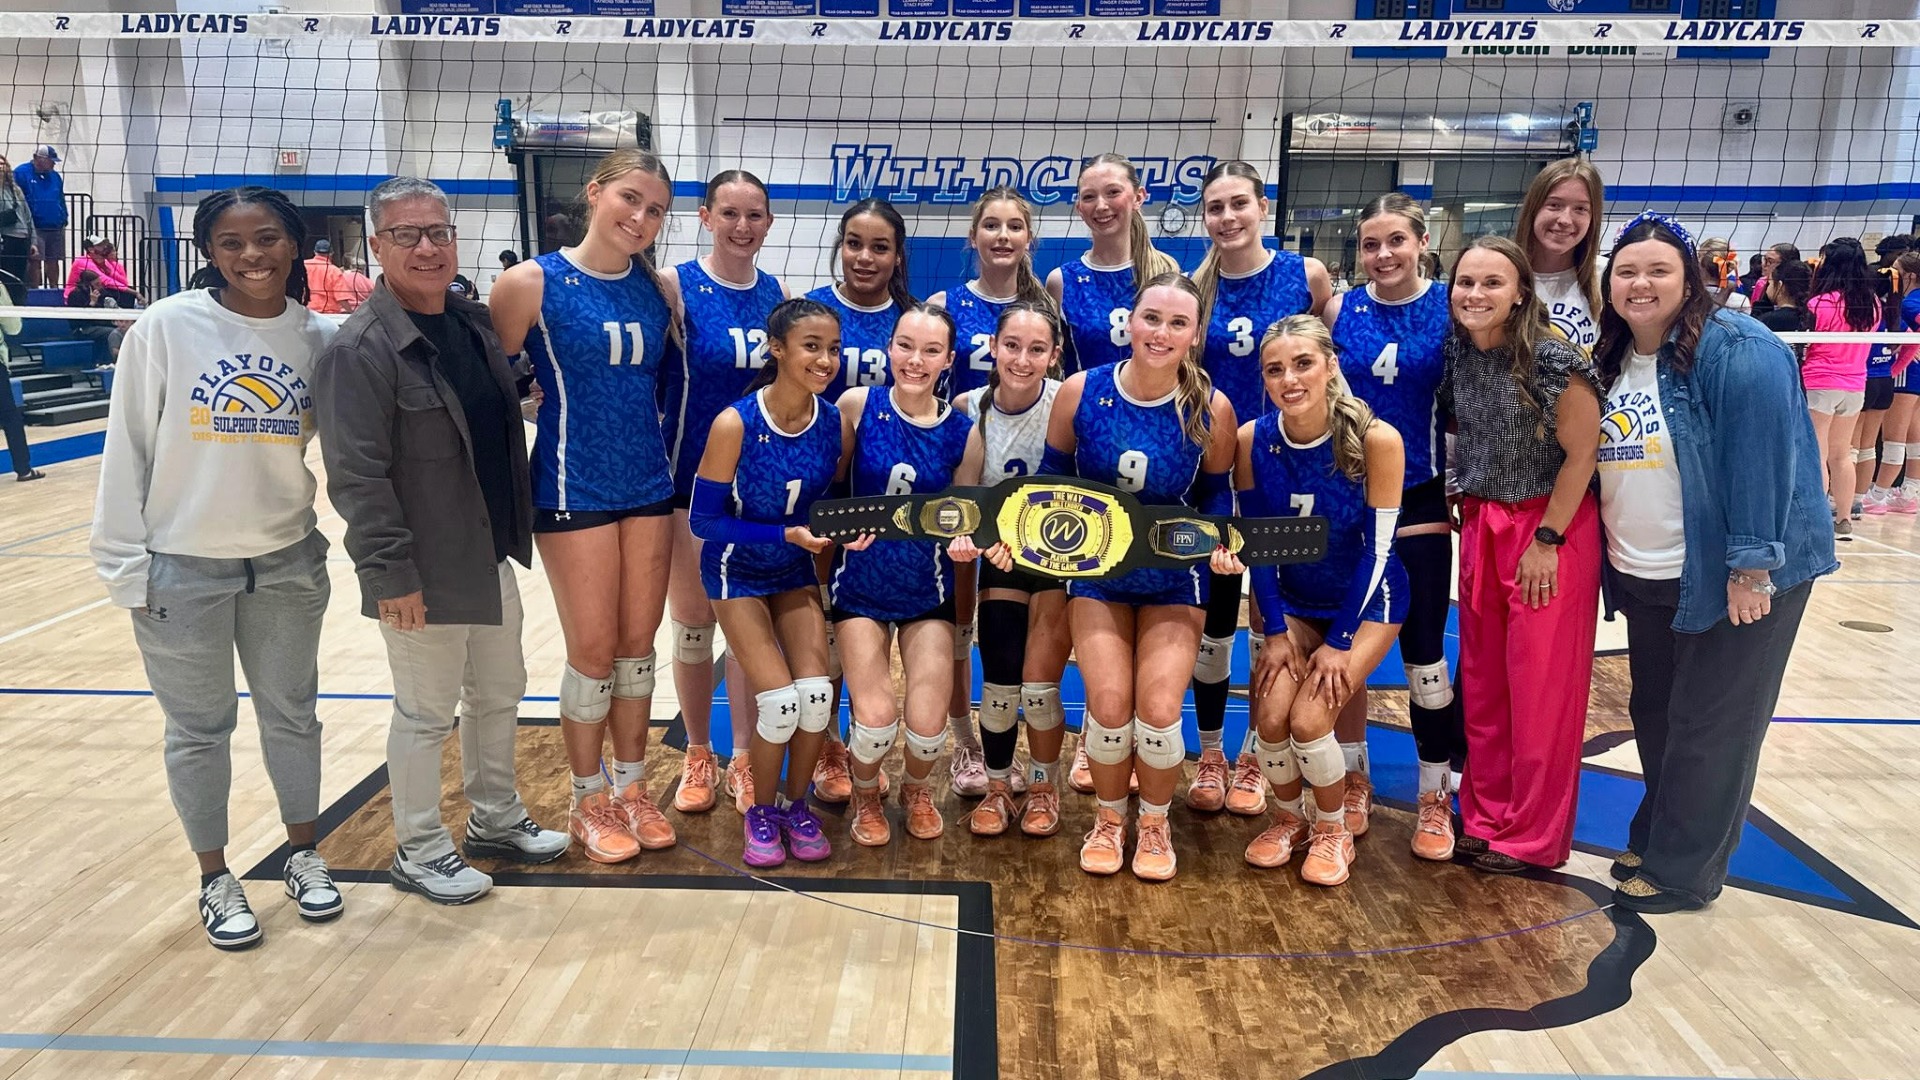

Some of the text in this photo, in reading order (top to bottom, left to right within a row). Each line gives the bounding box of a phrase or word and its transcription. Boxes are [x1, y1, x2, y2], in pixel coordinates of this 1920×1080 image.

[121, 14, 249, 33] LADYCATS
[370, 16, 501, 36] LADYCATS
[623, 19, 756, 38] LADYCATS
[878, 21, 1013, 41] LADYCATS
[1137, 21, 1274, 41] LADYCATS
[1398, 21, 1538, 40] LADYCATS
[1664, 21, 1806, 41] LADYCATS
[282, 152, 298, 164] EXIT
[830, 144, 1218, 207] WILDCTS
[602, 321, 645, 366] 11
[1109, 307, 1133, 347] 8
[1227, 316, 1255, 357] 3
[728, 327, 771, 369] 12
[1371, 342, 1400, 385] 4
[191, 353, 313, 410] PLAYOFFS
[843, 347, 888, 387] 13
[189, 406, 211, 426] 20
[214, 416, 300, 436] SULPHUR SPRINGS
[1604, 392, 1660, 435] AYOFFS
[192, 432, 248, 444] DISTRICT
[1617, 444, 1645, 460] SPRINGS
[885, 462, 917, 496] 6
[1116, 450, 1149, 494] 9
[784, 479, 802, 516] 1
[1053, 491, 1084, 503] THE WAY
[1290, 493, 1315, 518] 7
[1176, 534, 1193, 544] FPN
[1040, 559, 1079, 571] OF THE GAME
